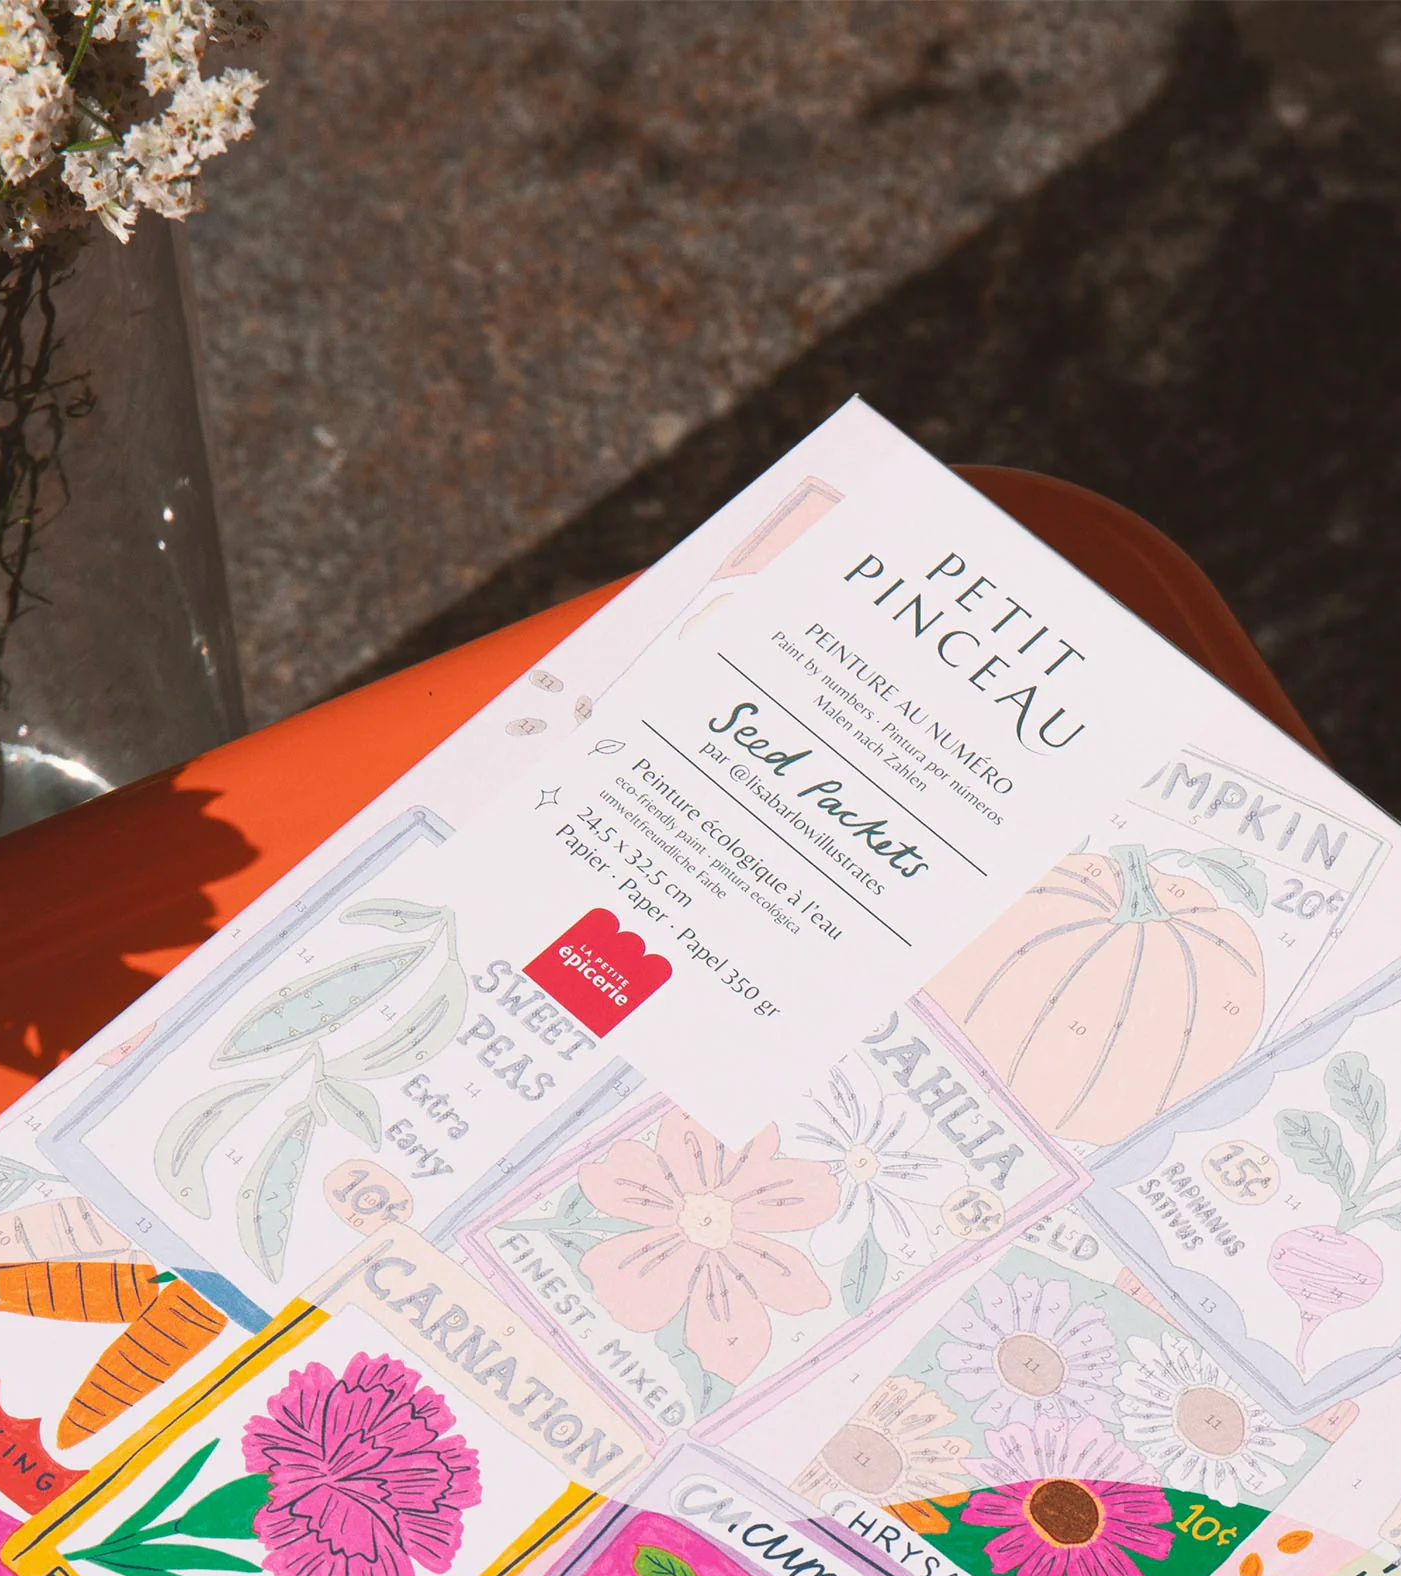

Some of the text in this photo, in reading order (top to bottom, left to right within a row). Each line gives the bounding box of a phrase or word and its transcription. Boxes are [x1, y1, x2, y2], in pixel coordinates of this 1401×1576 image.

[843, 553, 1086, 756] PINCEAU
[924, 552, 1086, 678] PETIT
[771, 631, 1005, 826] Paint by numbers Pintura por números
[805, 623, 1014, 795] PEINTURE AU NUMÉRO
[813, 694, 927, 792] Malen nach Zahlen
[632, 758, 701, 821] Peinture
[701, 819, 788, 896] écologique
[787, 890, 801, 906] à
[699, 741, 885, 896] par @lisabarlowillustrates
[708, 702, 929, 877] Seed Packets
[1140, 761, 1348, 870] MPKIN
[576, 806, 693, 907] 24,5 x 32,5 cm
[599, 789, 727, 900] umweltfreundliche Farbe
[615, 775, 801, 935] eco-friendly paint pintura ecológica
[555, 823, 781, 1017] Papier Paper Papel 350 gr
[1271, 879, 1345, 920] 20¢
[470, 960, 597, 1061] SWEET
[558, 944, 628, 1007] épicerie
[579, 944, 630, 988] LA PETITE
[400, 1073, 470, 1141] Extra
[456, 1014, 556, 1101] PEAS
[332, 1169, 409, 1222] 10¢
[384, 1118, 454, 1179] Early
[1209, 1143, 1272, 1199] 15¢
[950, 1190, 1001, 1233] 15¢
[1137, 1177, 1204, 1252] SATIVUS
[1160, 1161, 1245, 1258] RAPHANUS
[364, 1256, 623, 1478] CARNATION
[500, 1232, 686, 1427] FINEST MIXED
[1175, 1503, 1237, 1548] 10¢
